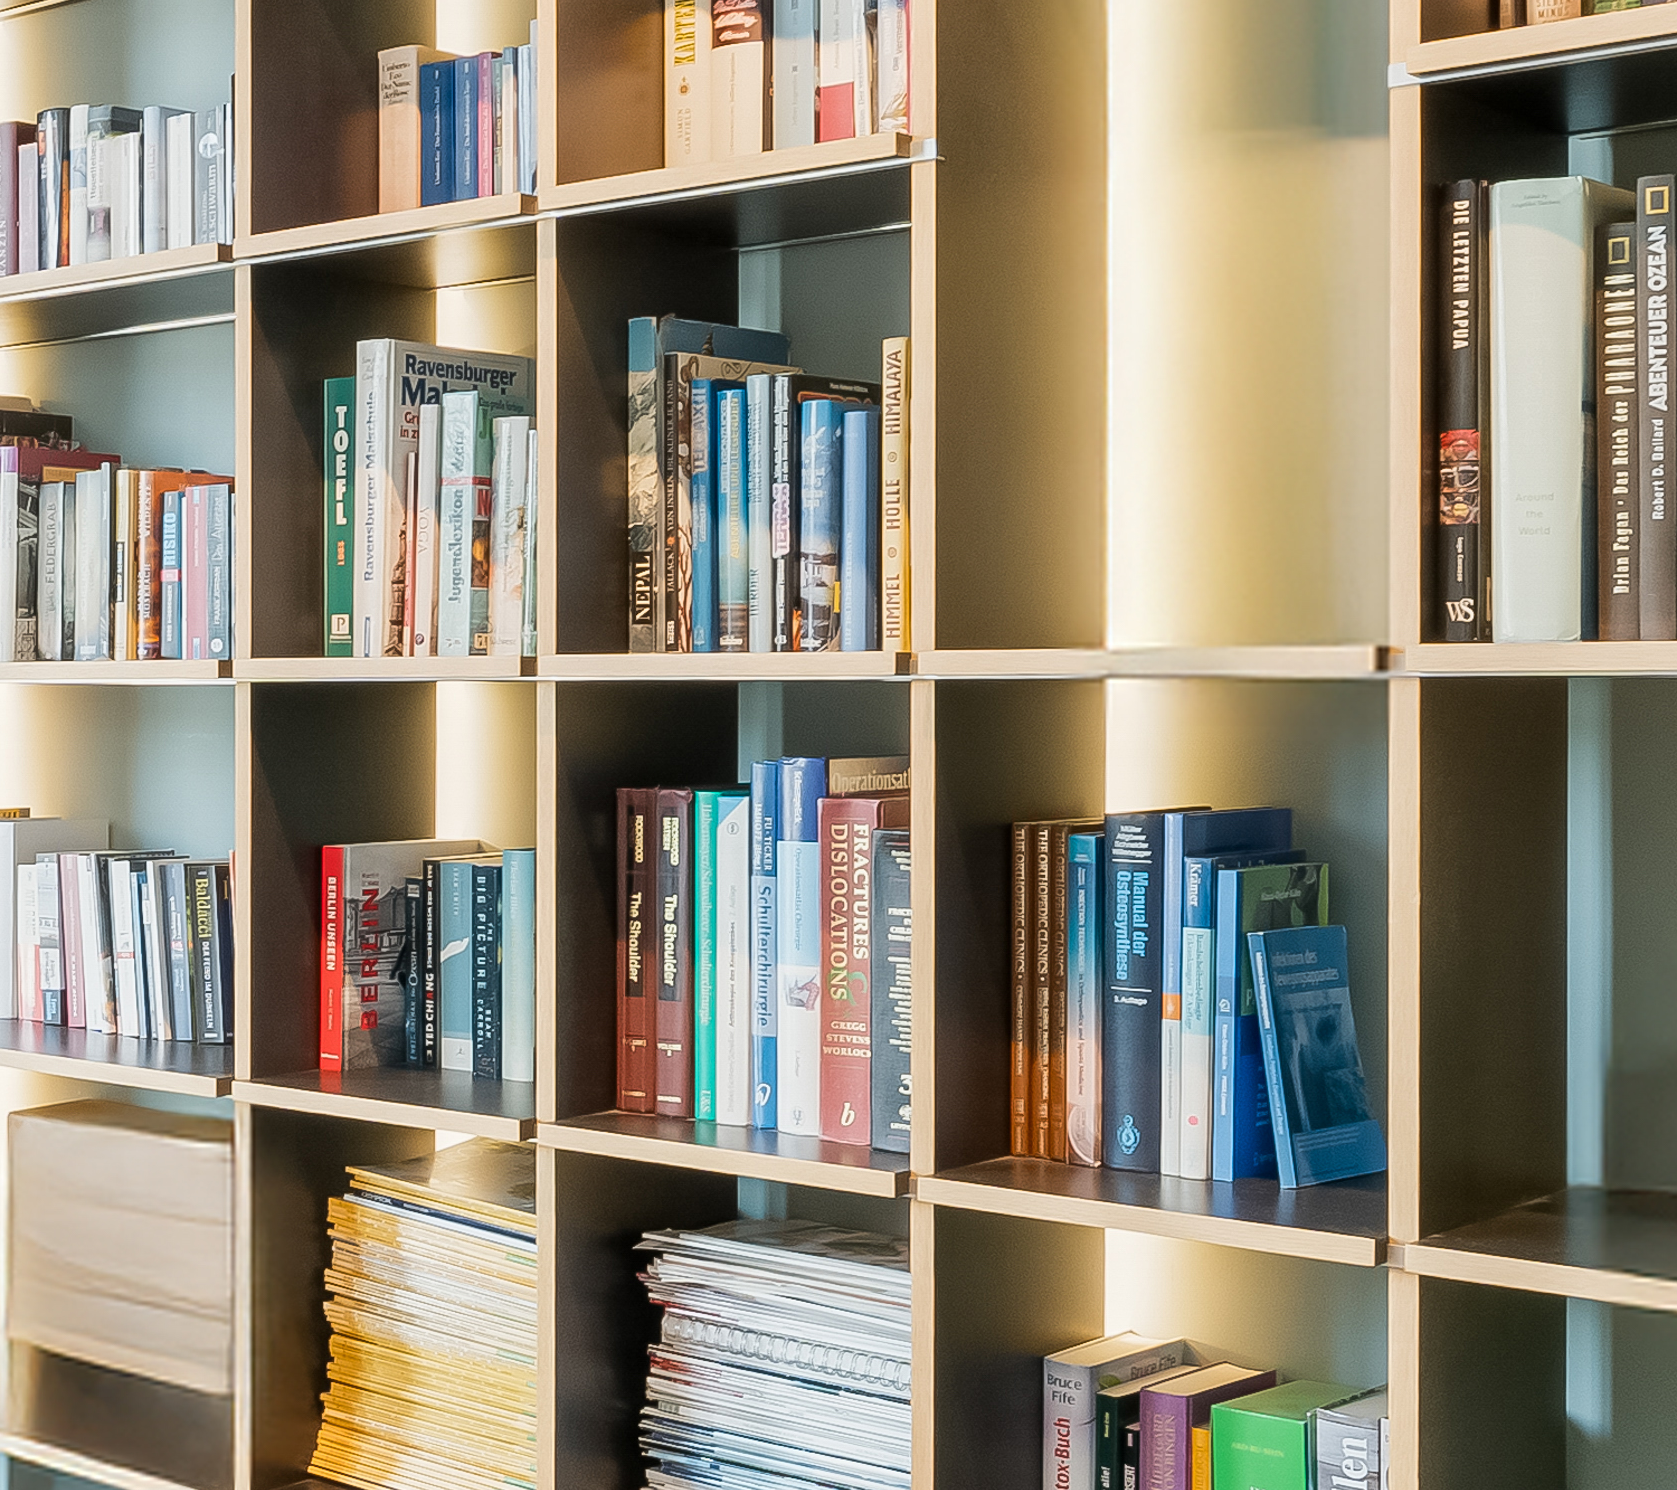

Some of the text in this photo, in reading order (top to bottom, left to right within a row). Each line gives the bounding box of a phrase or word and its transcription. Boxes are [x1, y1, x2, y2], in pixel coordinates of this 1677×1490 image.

[1453, 200, 1469, 350] DIE LETZTEN PAPUA
[1647, 225, 1667, 291] OZEAN
[405, 354, 516, 386] Ravensburger
[364, 474, 375, 582] Ravensburger
[635, 555, 651, 621] NEPAL
[829, 823, 849, 1002] DISLOCATIONS
[853, 823, 869, 959] FRACTURES
